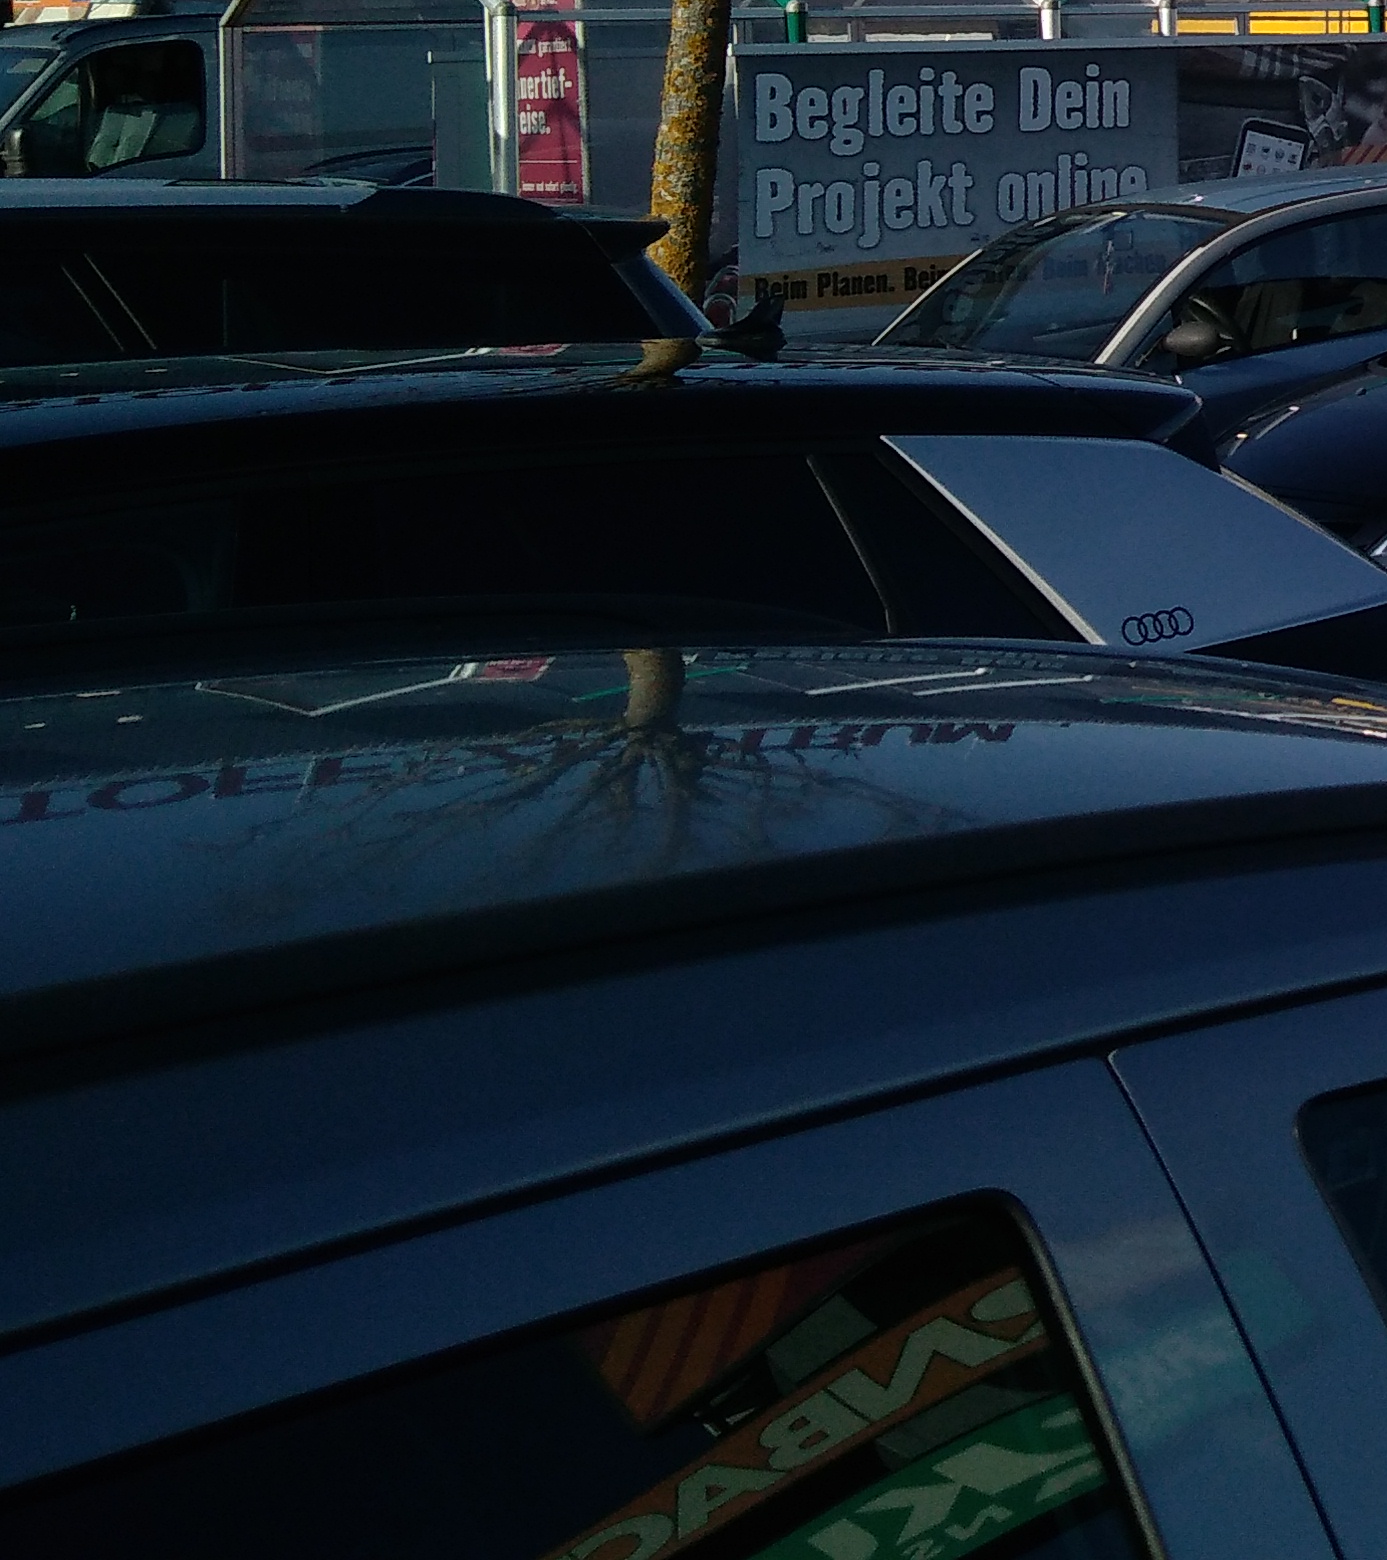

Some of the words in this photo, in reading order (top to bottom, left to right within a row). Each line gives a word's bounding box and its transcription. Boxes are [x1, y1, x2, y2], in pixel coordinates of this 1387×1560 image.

[516, 67, 573, 99] uertief-
[754, 66, 996, 157] Begleite
[1019, 63, 1131, 133] Dein
[754, 157, 976, 248] Projekt
[998, 151, 1149, 223] online
[755, 274, 808, 302] Beim
[817, 269, 896, 298] Planen.
[903, 264, 957, 292] Bei
